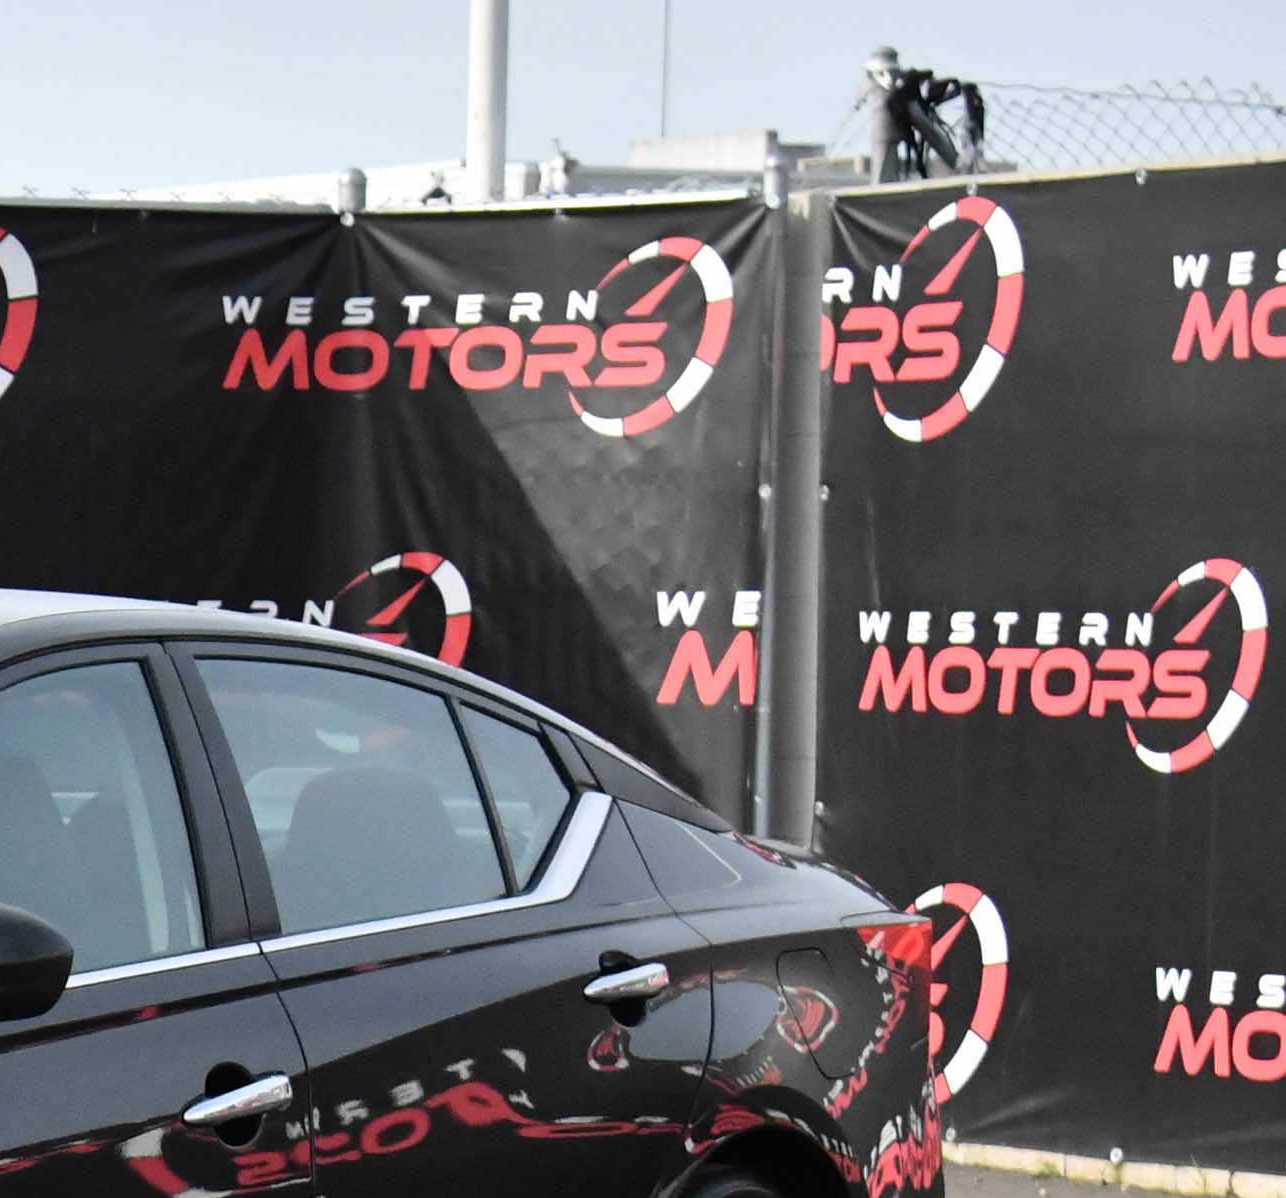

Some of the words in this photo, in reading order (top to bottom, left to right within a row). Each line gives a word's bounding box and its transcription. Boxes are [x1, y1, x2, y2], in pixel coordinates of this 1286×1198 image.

[223, 291, 599, 325] WESTERN
[224, 322, 667, 390] MOTORS
[858, 610, 1154, 647] WESTERN
[859, 645, 1211, 719] MOTORS
